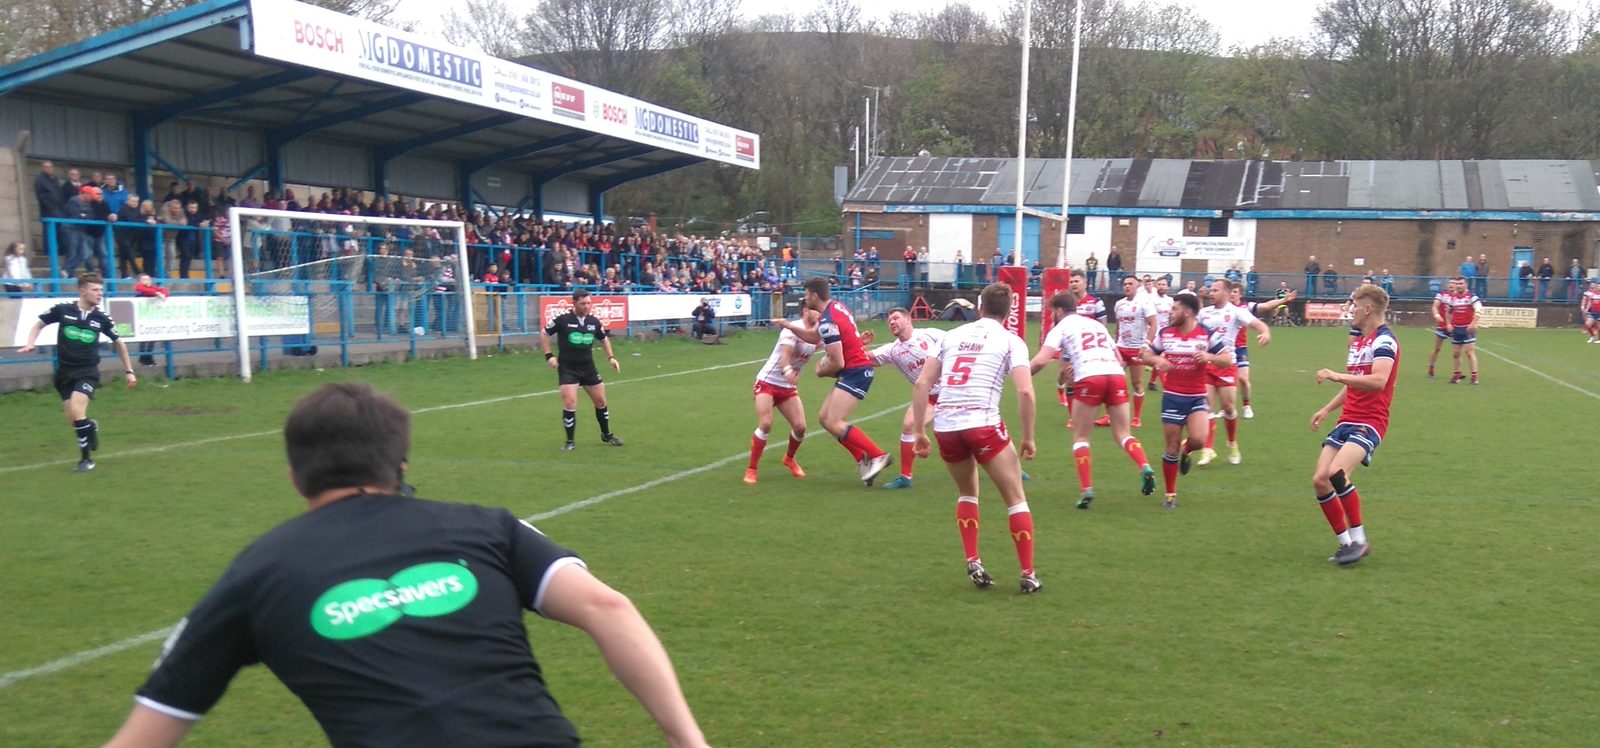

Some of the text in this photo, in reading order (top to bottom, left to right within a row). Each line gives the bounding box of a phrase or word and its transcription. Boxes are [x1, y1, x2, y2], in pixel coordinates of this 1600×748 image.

[294, 20, 345, 54] BOSCH
[602, 103, 628, 125] BOSCH
[1495, 308, 1535, 317] LIMITED
[139, 322, 222, 335] Constructing Careers
[958, 341, 984, 353] SHAW
[1081, 332, 1108, 351] 22
[947, 356, 977, 386] 5
[324, 573, 464, 626] Specsavers
